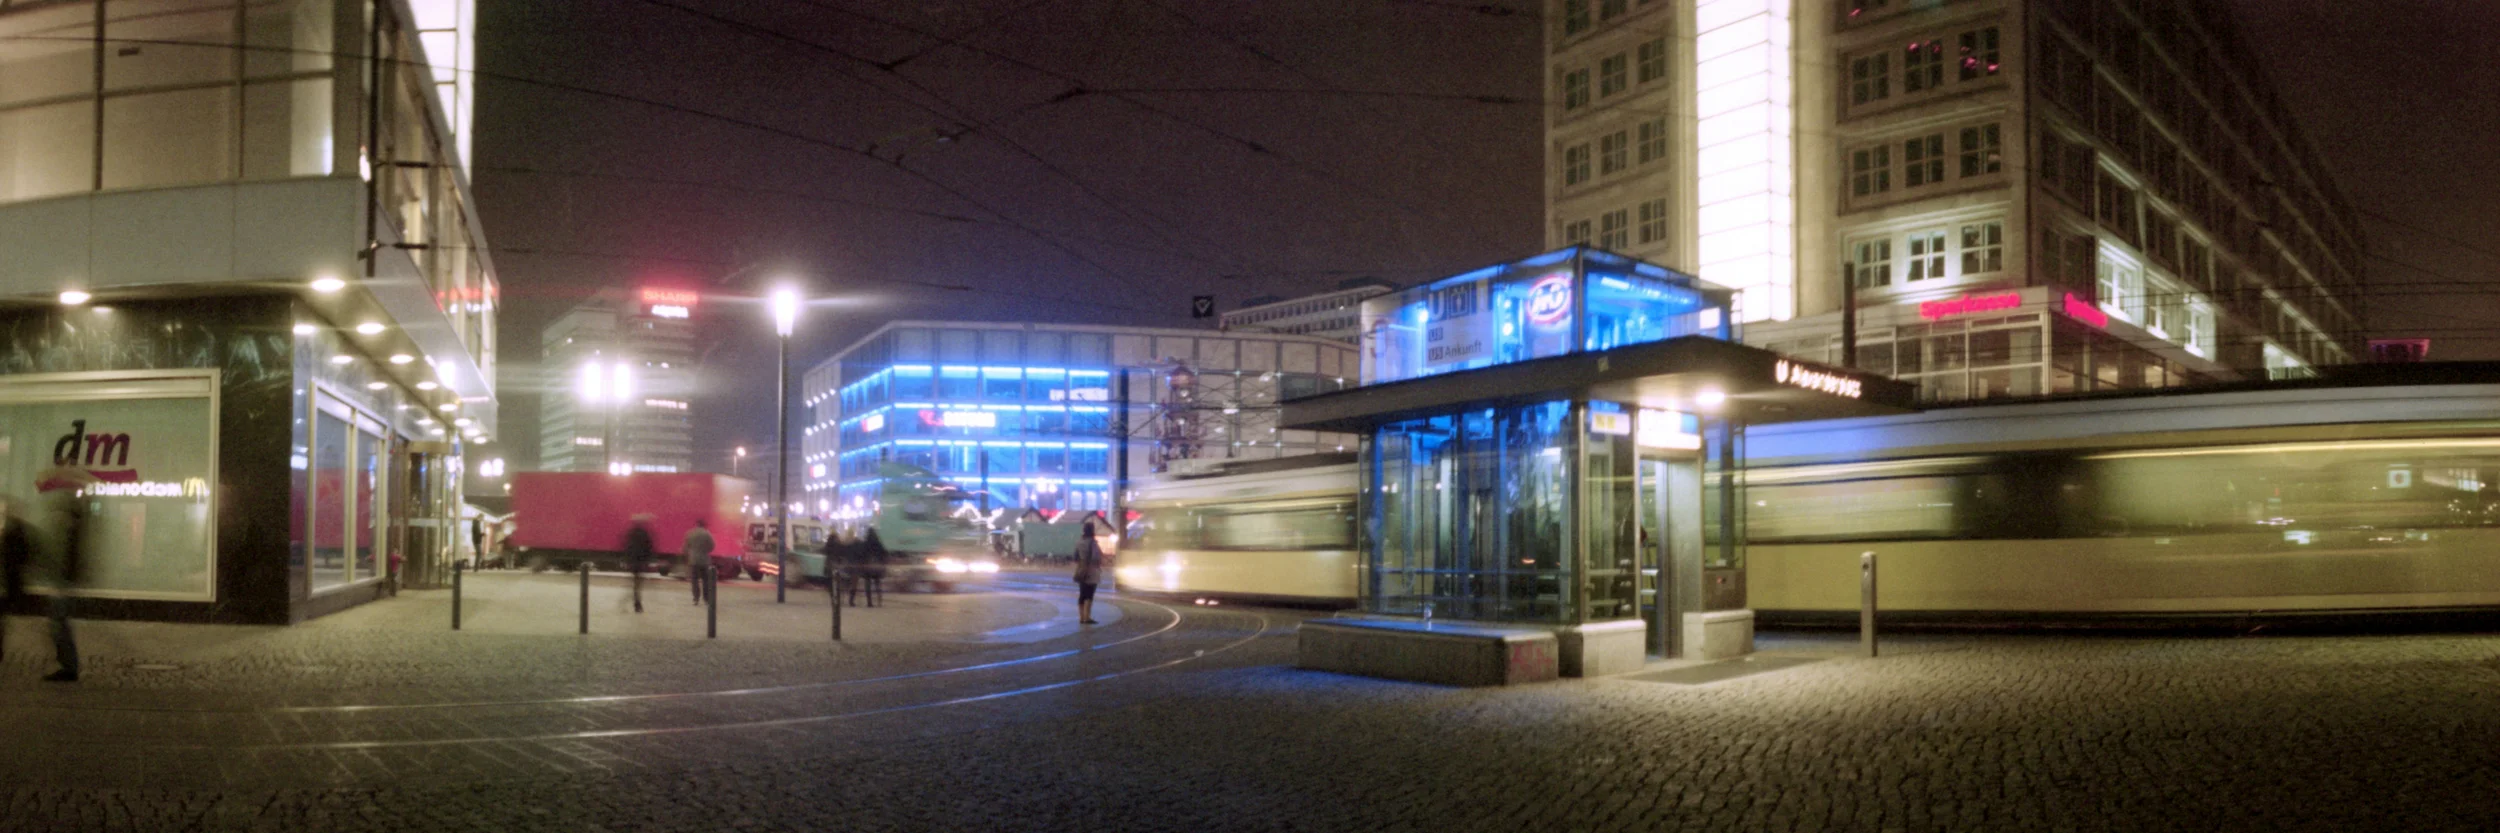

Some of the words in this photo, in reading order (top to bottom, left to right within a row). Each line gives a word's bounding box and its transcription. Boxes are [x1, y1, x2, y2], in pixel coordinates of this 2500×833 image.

[1445, 338, 1482, 357] Ankunft
[1775, 359, 1789, 384] U
[53, 418, 131, 467] dm
